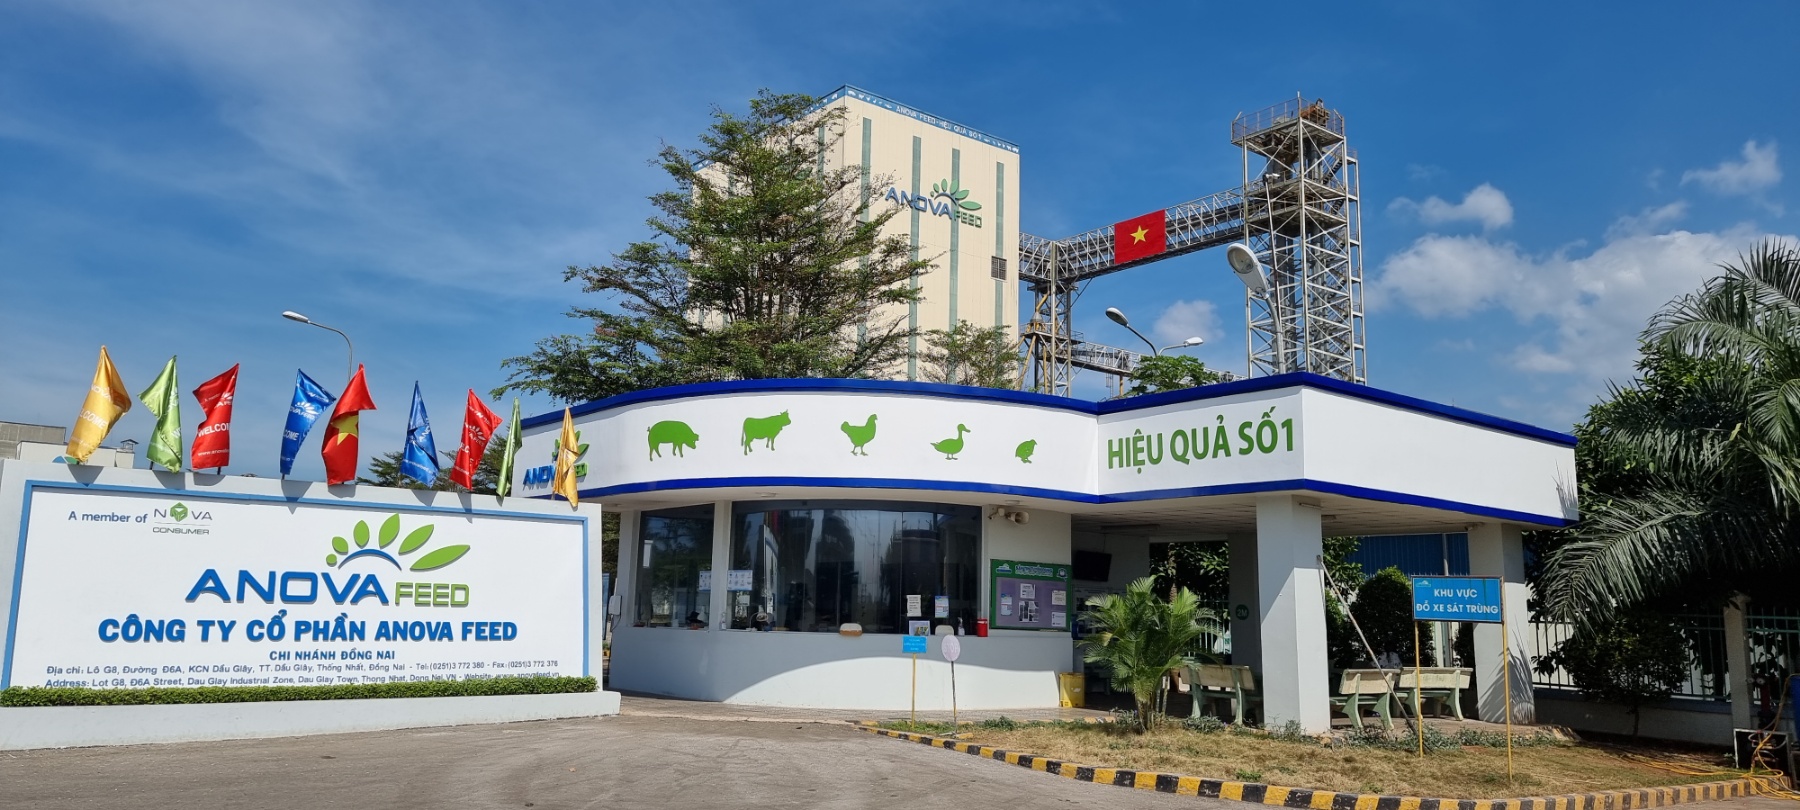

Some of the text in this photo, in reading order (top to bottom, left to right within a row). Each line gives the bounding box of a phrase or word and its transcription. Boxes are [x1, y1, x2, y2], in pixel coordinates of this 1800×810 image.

[895, 105, 918, 118] ANOVA
[885, 187, 982, 228] ANOVA FEED
[198, 422, 230, 437] WELCO
[1107, 428, 1164, 475] HIỆU
[1170, 414, 1232, 465] QUẢ
[68, 511, 77, 521] A
[82, 512, 131, 523] member
[135, 513, 148, 523] of
[152, 526, 210, 535] CONSUMER
[185, 568, 470, 608] ANOVA FEED
[1434, 588, 1478, 600] KHU VỰC
[1433, 604, 1444, 612] XE
[1447, 602, 1463, 613] SÁT
[1466, 602, 1499, 614] TRÙNG
[98, 609, 518, 643] CÔNG TY CỔ PHẦN ANOVA FEED
[269, 647, 396, 661] CHI NHÁNH ĐỒNG NAI
[46, 665, 63, 676] Địa
[87, 665, 100, 674] Lô
[103, 665, 120, 676] G8,
[122, 665, 158, 675] Đường
[162, 665, 185, 675] Đ6A,
[188, 665, 210, 673] KCN
[259, 664, 273, 672] TT.
[317, 662, 342, 673] Thống
[392, 663, 405, 671] Nai
[457, 662, 471, 670] 772
[472, 661, 485, 669] 380
[533, 660, 546, 668] 772
[45, 679, 90, 688] Address:
[92, 678, 108, 687] Lot
[111, 678, 127, 688] G8,
[130, 678, 150, 686] Đ6A
[153, 677, 185, 686] Street,
[187, 677, 205, 686] Dau
[207, 677, 228, 687] Giay
[230, 676, 270, 685] Industrial
[272, 676, 296, 685] Zone,
[298, 675, 314, 684] Dau
[316, 675, 335, 685] Giay
[337, 675, 360, 684] Town,
[362, 675, 386, 684] Thong
[388, 674, 408, 683] Nhat,
[409, 674, 429, 682] Dong
